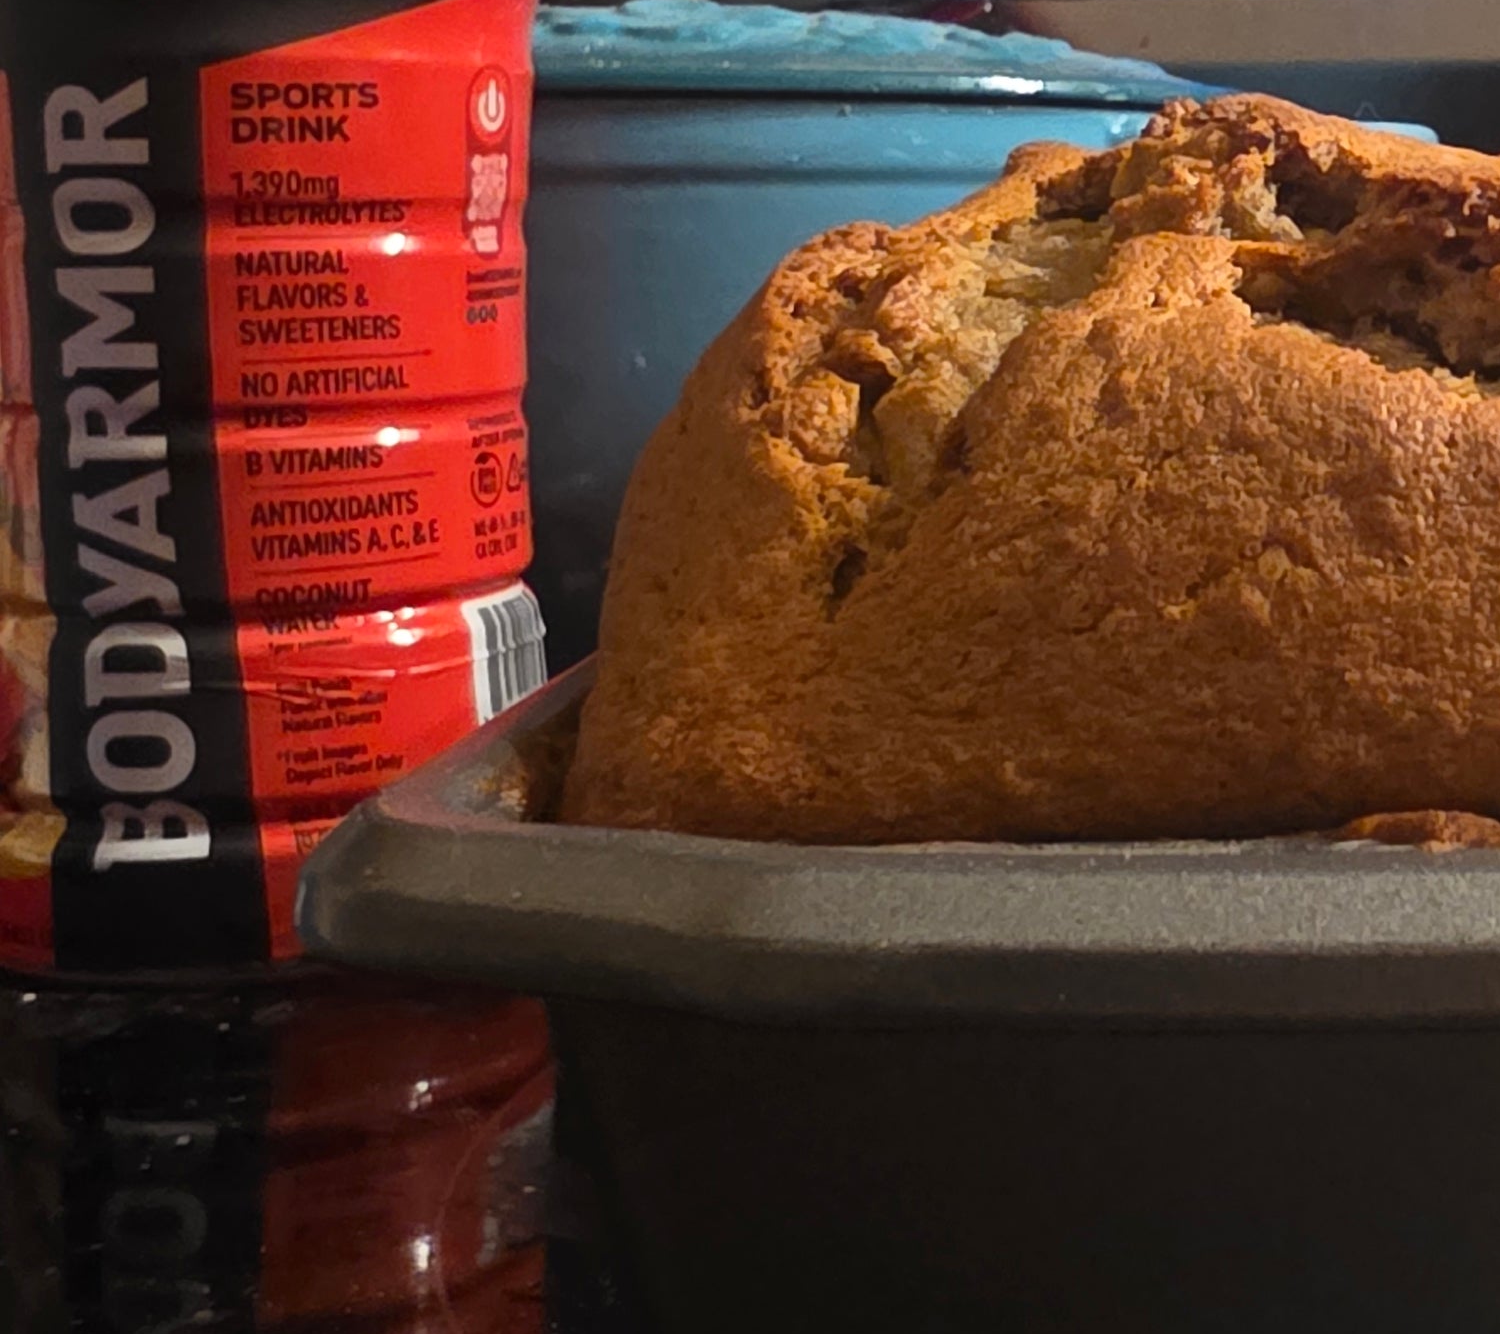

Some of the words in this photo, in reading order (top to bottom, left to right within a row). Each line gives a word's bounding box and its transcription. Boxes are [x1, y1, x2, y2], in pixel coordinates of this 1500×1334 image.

[229, 82, 380, 111] SPORTS
[231, 114, 351, 144] DRINK
[234, 249, 350, 277] NATURAL
[236, 281, 348, 312] FLAVORS
[353, 283, 370, 308] &
[238, 314, 402, 346] SWEETENERS
[240, 371, 279, 398] NO
[285, 364, 411, 397] ARTIFICIAL
[243, 403, 309, 430] DYES
[43, 75, 211, 871] BODYARMOR
[245, 450, 263, 477] B
[269, 444, 384, 475] VITAMINS
[250, 488, 419, 528] ANTIOXIDANTS
[251, 527, 362, 562] VITAMINS
[412, 521, 427, 545] &
[428, 518, 441, 544] E
[255, 577, 373, 607] COCONUT
